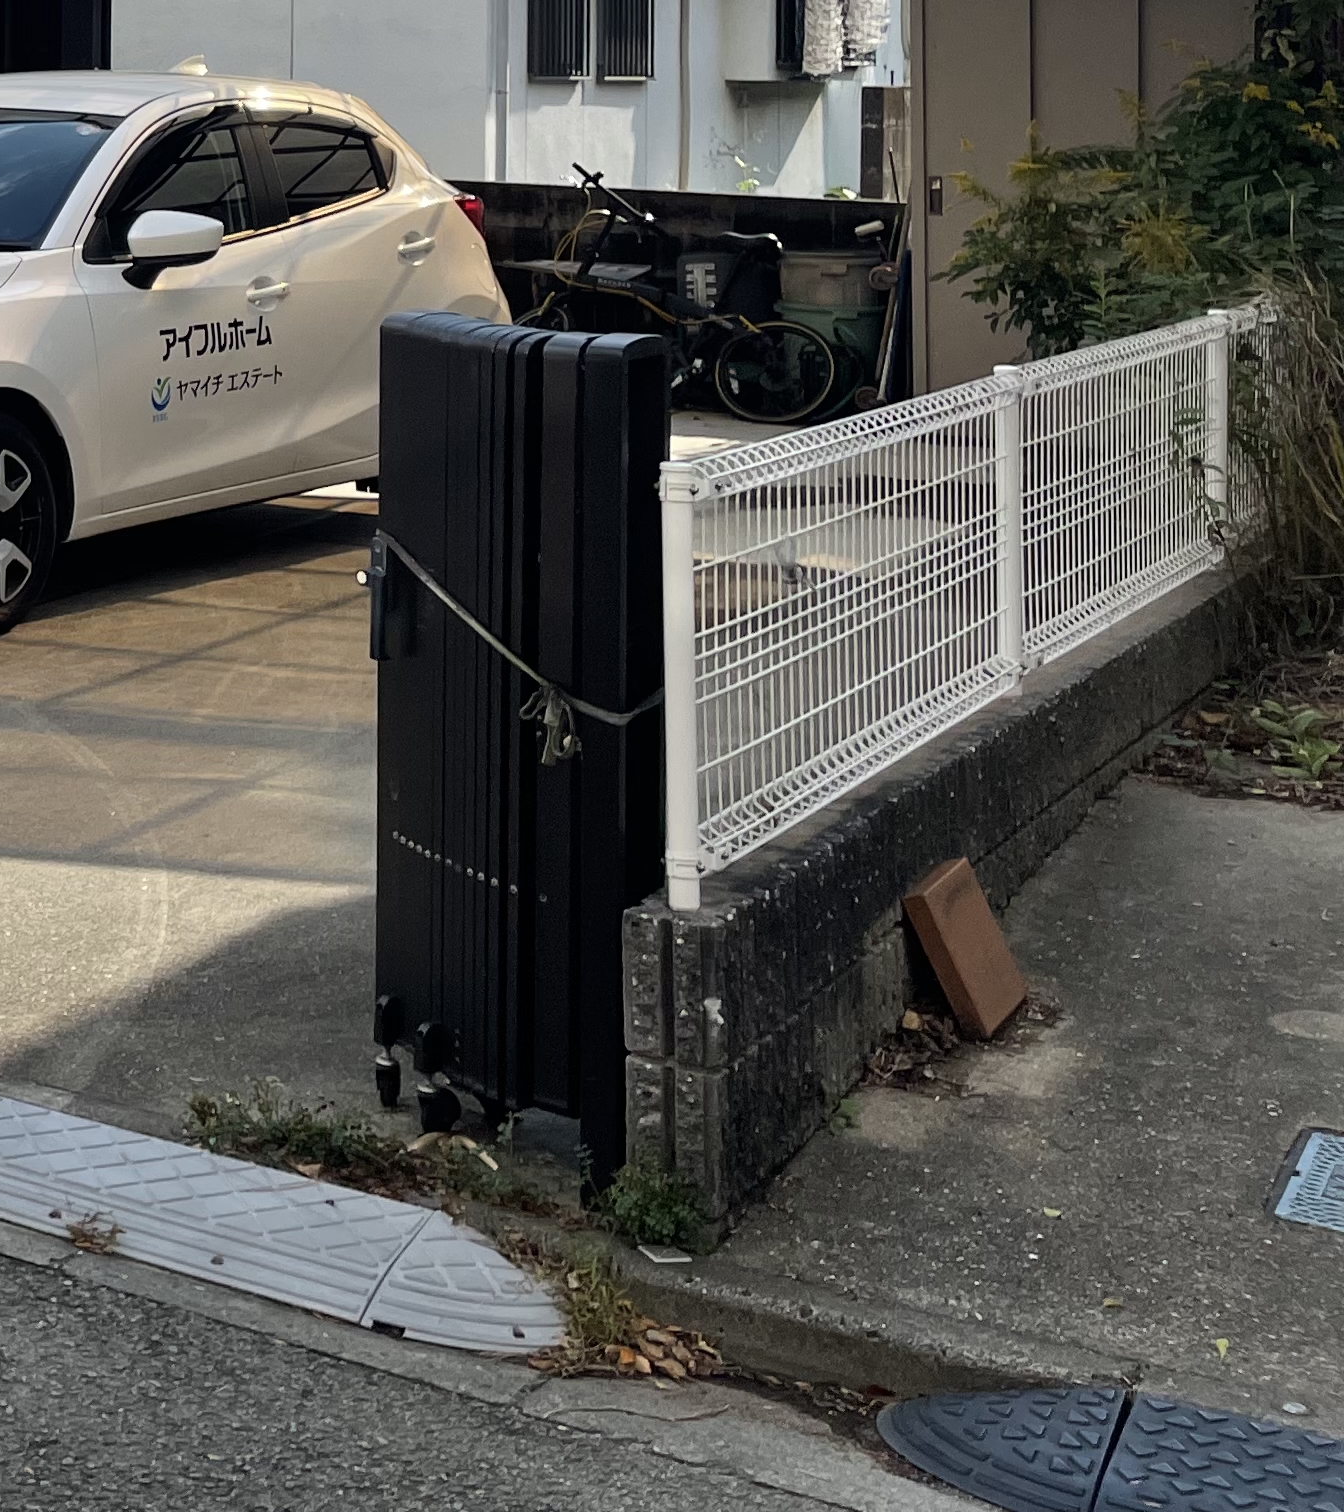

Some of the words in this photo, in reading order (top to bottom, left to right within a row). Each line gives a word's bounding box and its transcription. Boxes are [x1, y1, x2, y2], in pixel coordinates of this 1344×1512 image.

[159, 315, 273, 362] アイフルホーム
